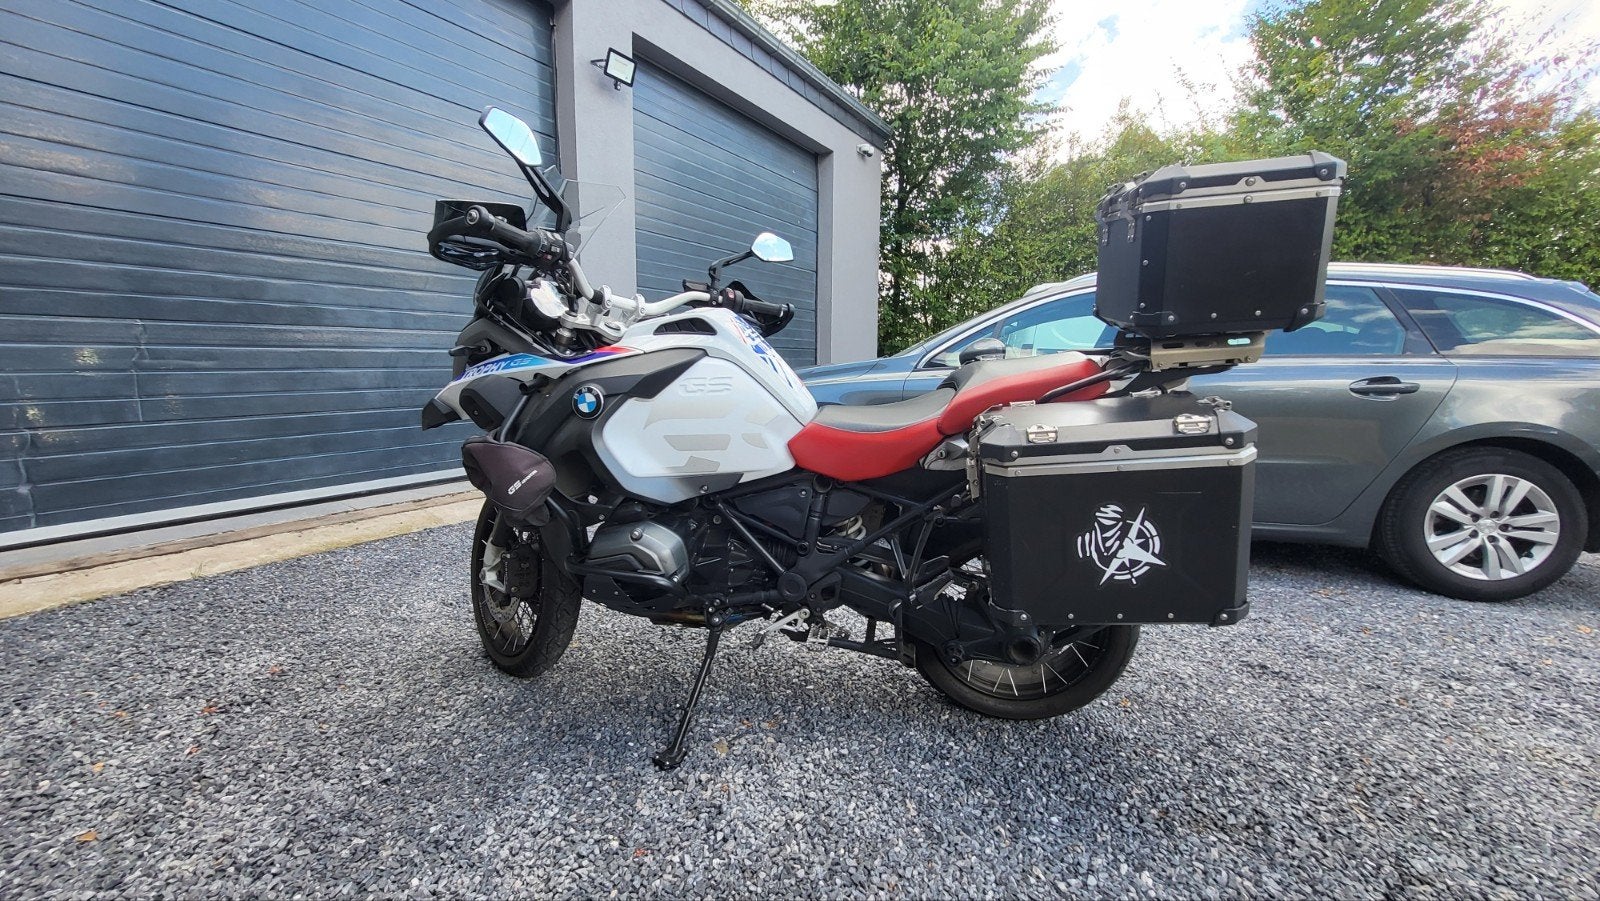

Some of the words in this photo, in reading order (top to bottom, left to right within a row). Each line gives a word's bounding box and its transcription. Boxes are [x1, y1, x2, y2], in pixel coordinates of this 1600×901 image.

[462, 361, 509, 378] TROPHY
[509, 357, 533, 366] GS
[679, 377, 733, 396] GS
[508, 480, 522, 494] GS
